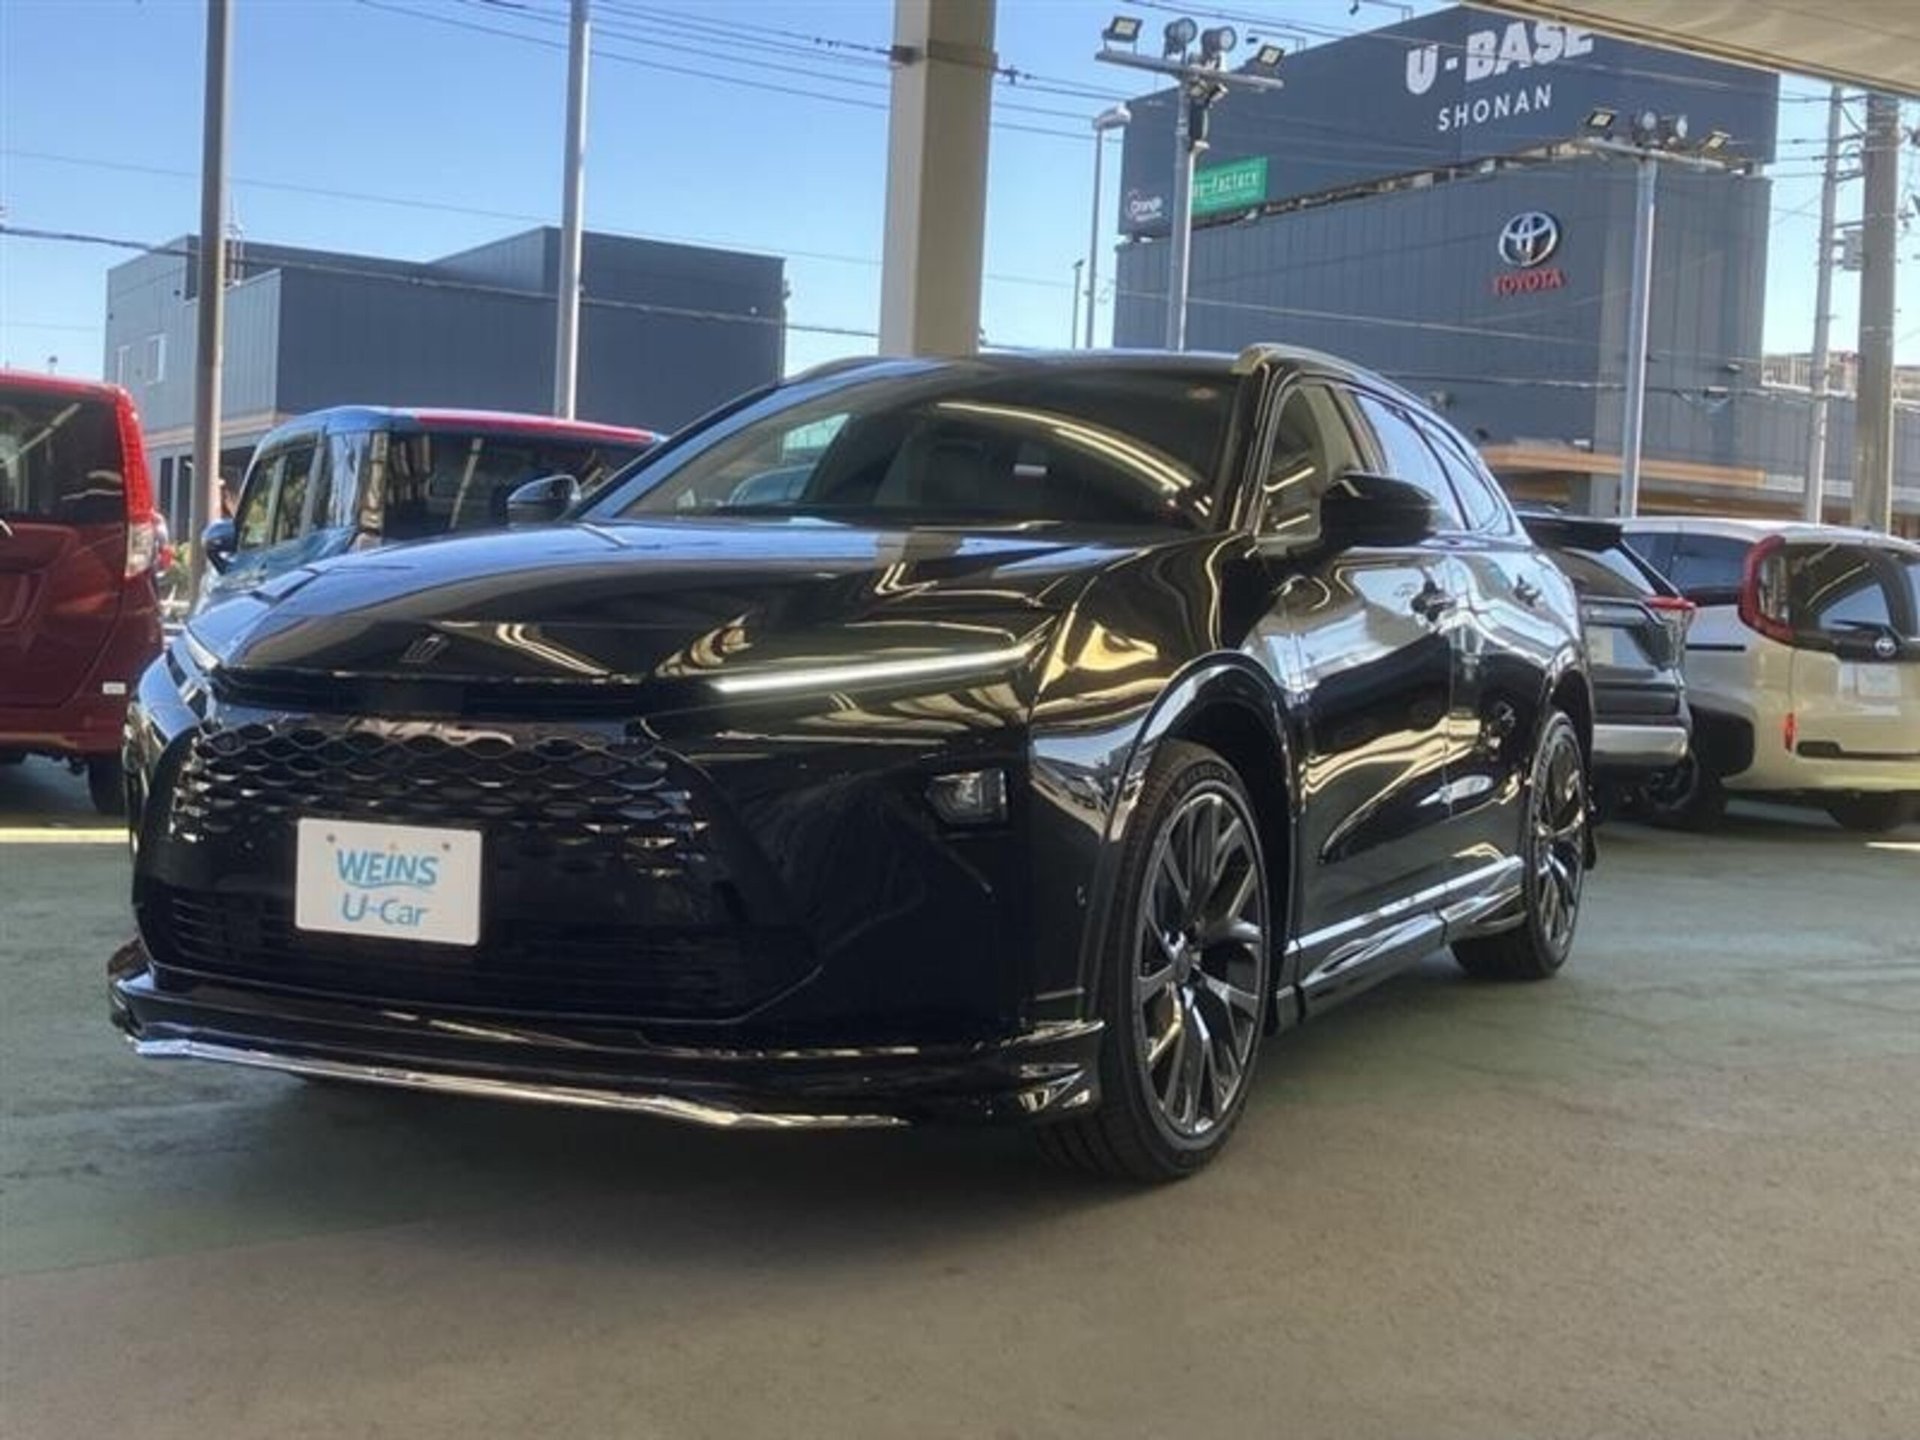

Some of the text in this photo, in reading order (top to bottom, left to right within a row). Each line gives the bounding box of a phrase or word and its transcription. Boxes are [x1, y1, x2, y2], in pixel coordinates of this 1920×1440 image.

[1437, 84, 1551, 131] SHONAN
[1493, 268, 1566, 297] TOYOTA
[337, 850, 438, 888] WEINS
[342, 892, 428, 926] U-Car
